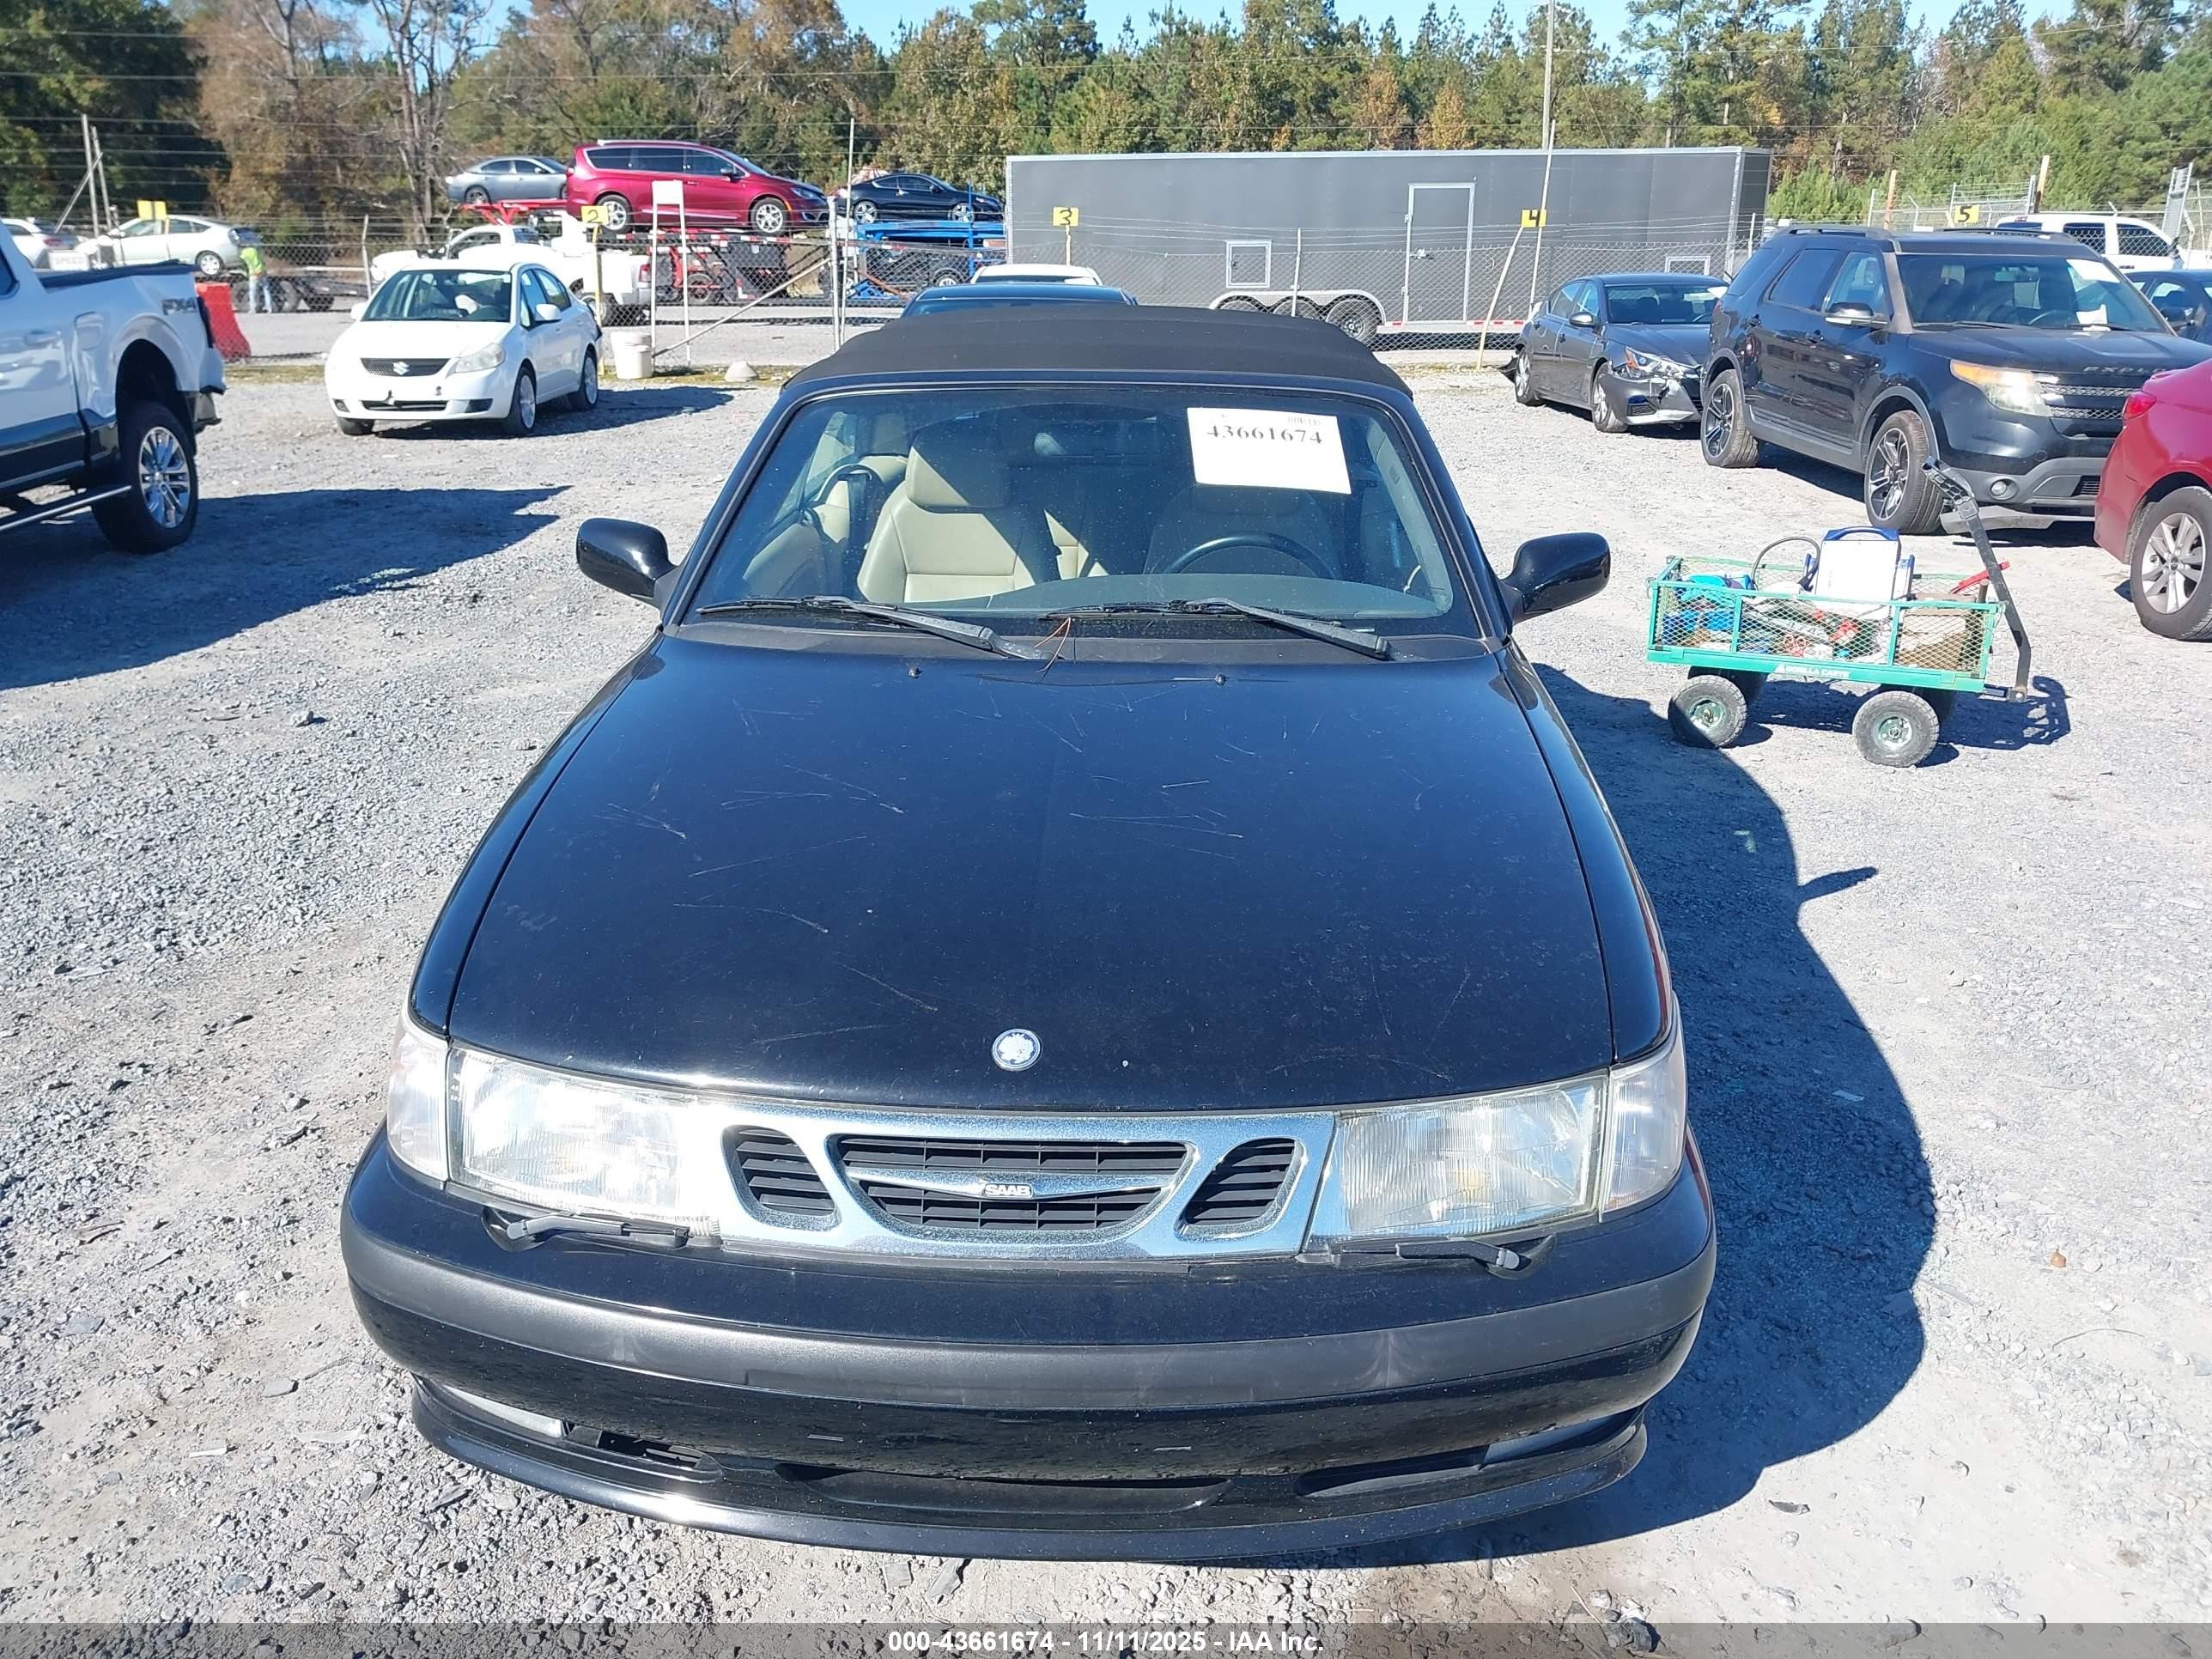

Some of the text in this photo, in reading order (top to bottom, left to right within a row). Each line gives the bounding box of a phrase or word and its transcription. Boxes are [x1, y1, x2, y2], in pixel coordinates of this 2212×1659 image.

[587, 210, 603, 223] 2
[1060, 209, 1073, 225] 3
[1529, 210, 1540, 227] 4
[1958, 205, 1972, 222] 5
[1206, 425, 1322, 444] 43661674
[985, 1185, 1030, 1196] SAAB
